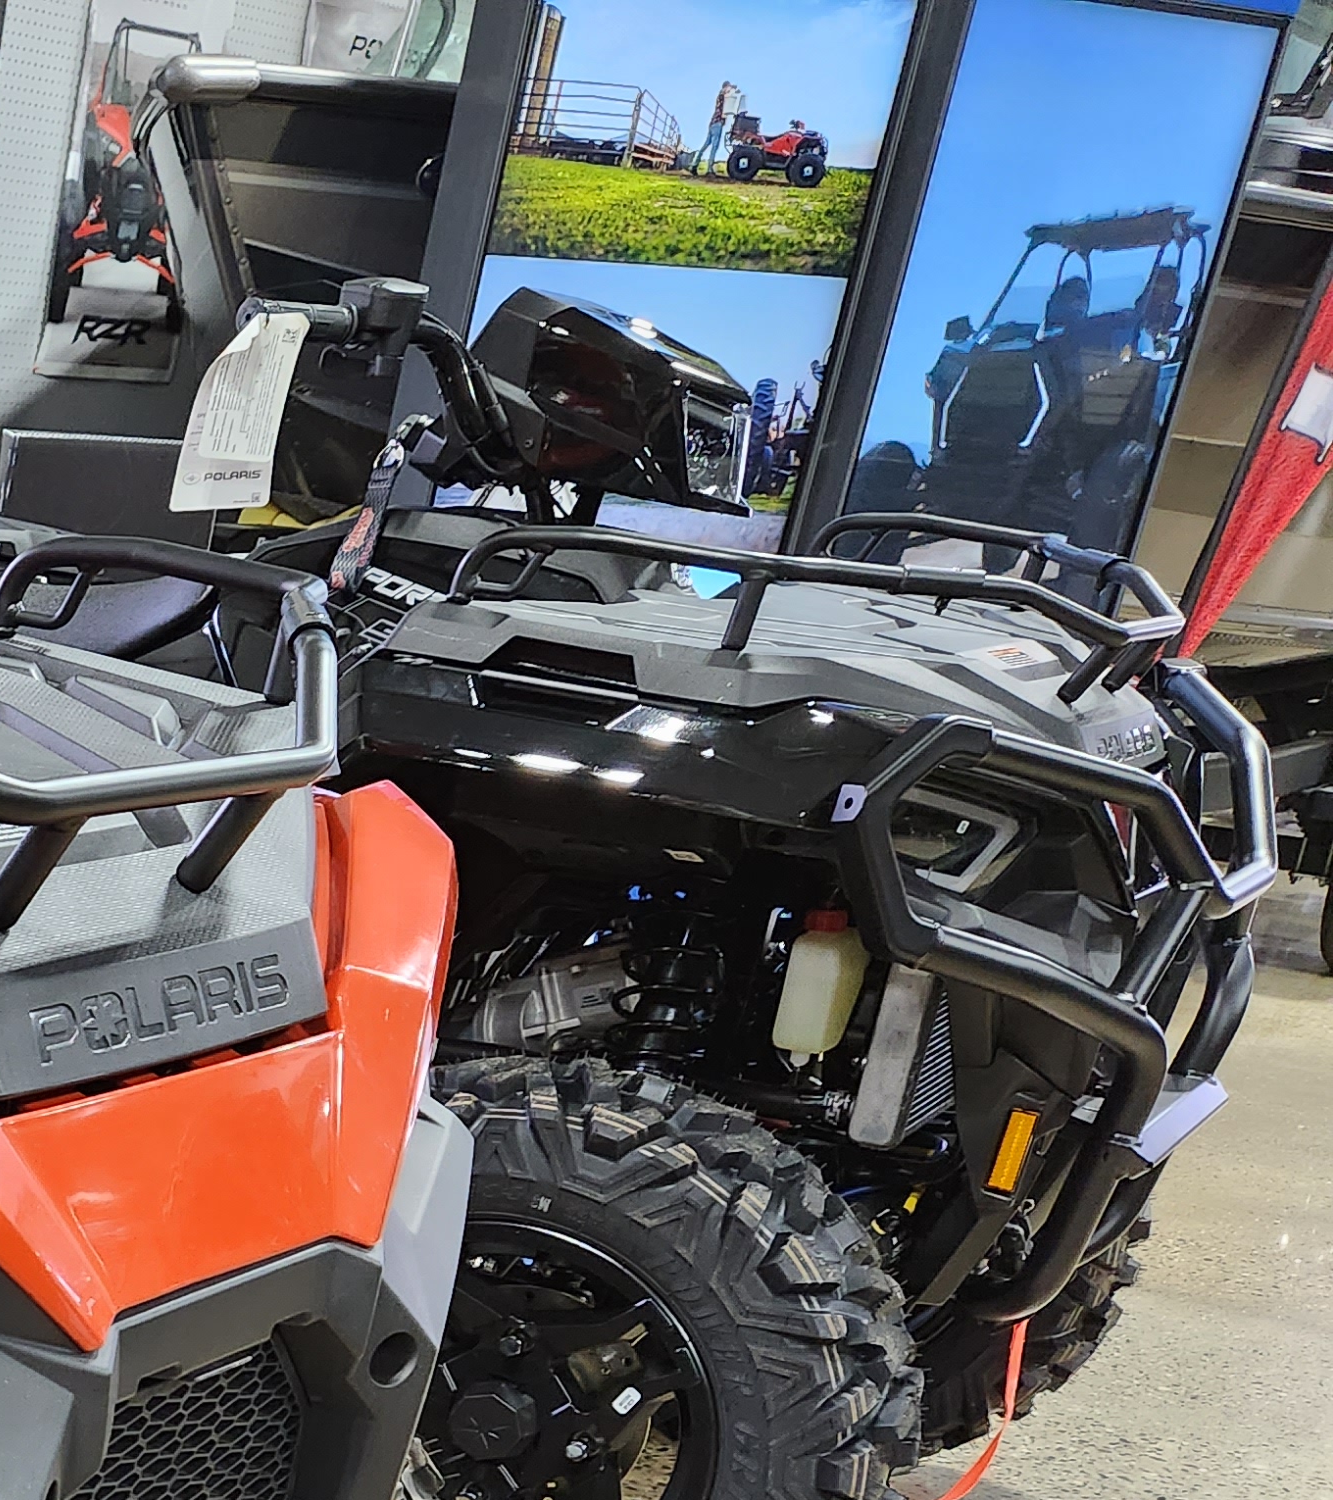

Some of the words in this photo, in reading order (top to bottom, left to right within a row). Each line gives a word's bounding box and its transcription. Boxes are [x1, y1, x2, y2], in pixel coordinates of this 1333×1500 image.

[72, 315, 151, 346] RZR
[204, 469, 261, 482] POLARIS
[29, 953, 290, 1066] POLARIS
